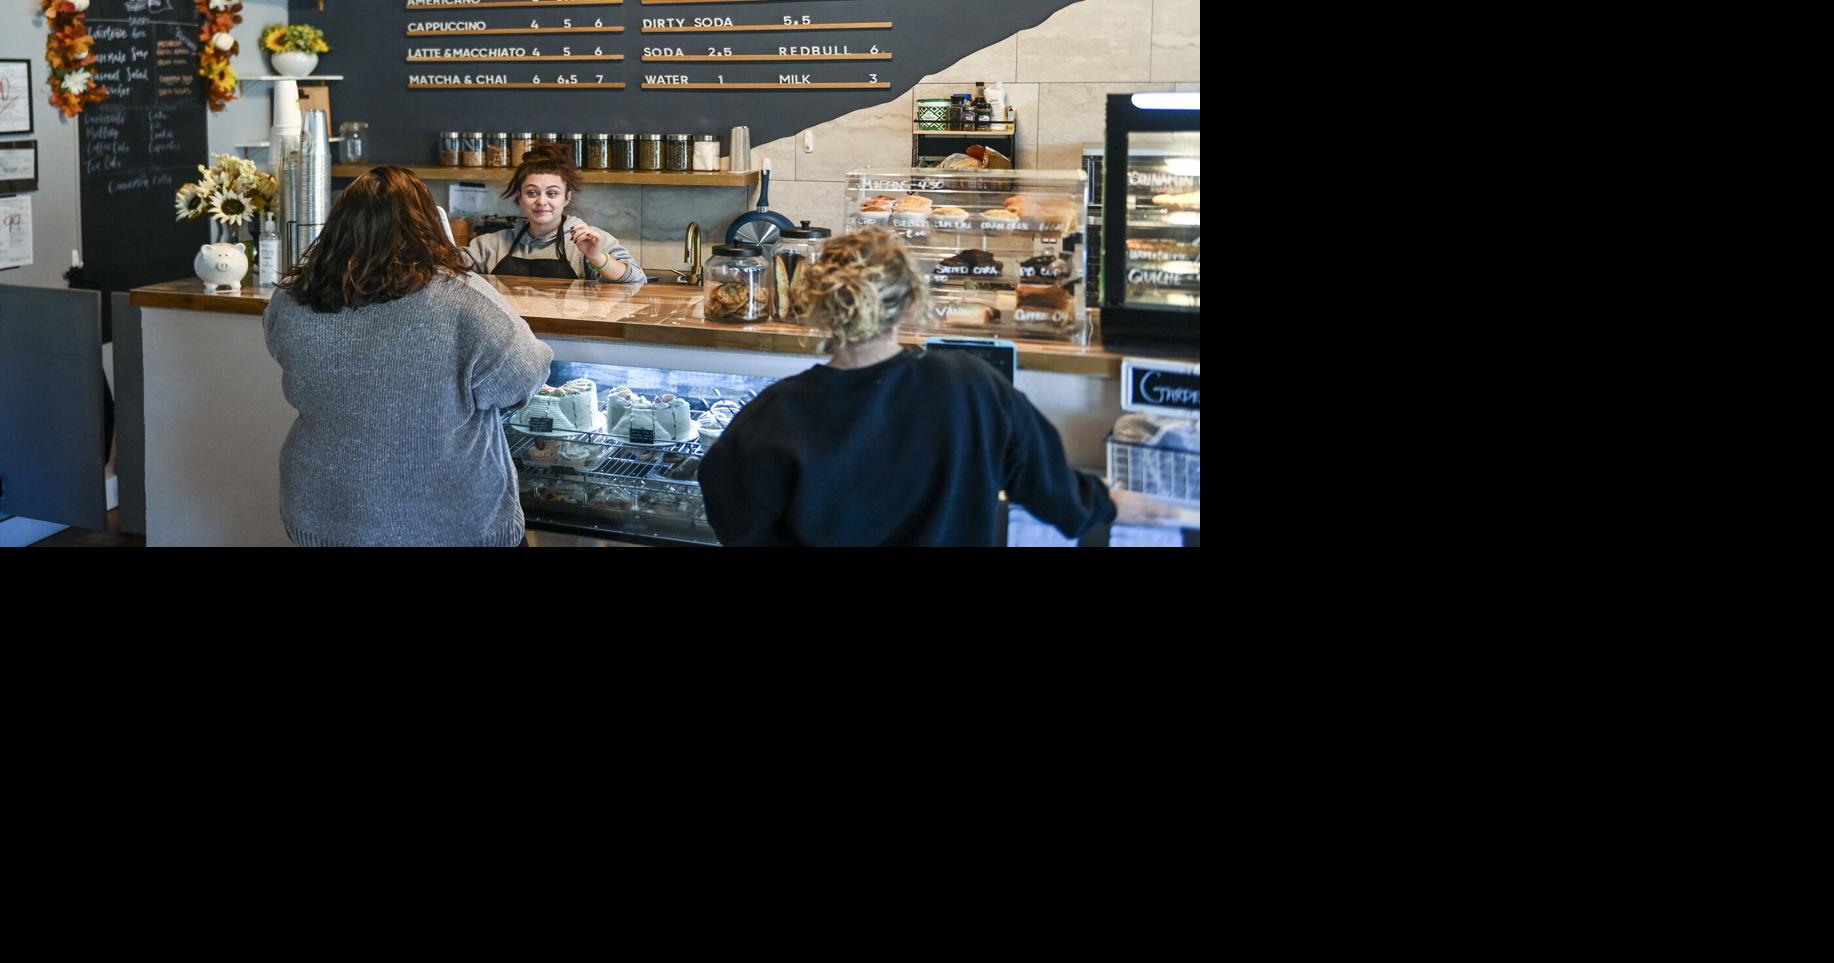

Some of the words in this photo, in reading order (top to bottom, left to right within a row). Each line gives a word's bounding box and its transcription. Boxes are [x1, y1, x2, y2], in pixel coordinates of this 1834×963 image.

[408, 21, 486, 32] CAPPUCCINO
[530, 19, 539, 29] 4
[563, 18, 572, 29] 5
[594, 18, 603, 28] 6
[643, 18, 685, 29] DIRTY
[694, 17, 733, 28] SODA
[783, 15, 811, 26] 5.5
[408, 48, 441, 58] LATTE
[532, 47, 540, 57] 4
[563, 47, 571, 57] 5
[594, 46, 603, 57] 6
[643, 47, 684, 57] SODA
[708, 47, 733, 57] 2.5
[778, 45, 852, 56] REDBULL
[870, 44, 879, 55] 6
[409, 75, 461, 85] MATCHA
[464, 75, 472, 85] &
[476, 75, 507, 85] CHAI
[532, 74, 541, 85] 6
[557, 74, 578, 85] 6.5
[596, 74, 603, 84] 7
[645, 75, 689, 85] WATER
[718, 75, 724, 85] 1
[779, 74, 811, 85] MILK
[869, 73, 878, 84] 3
